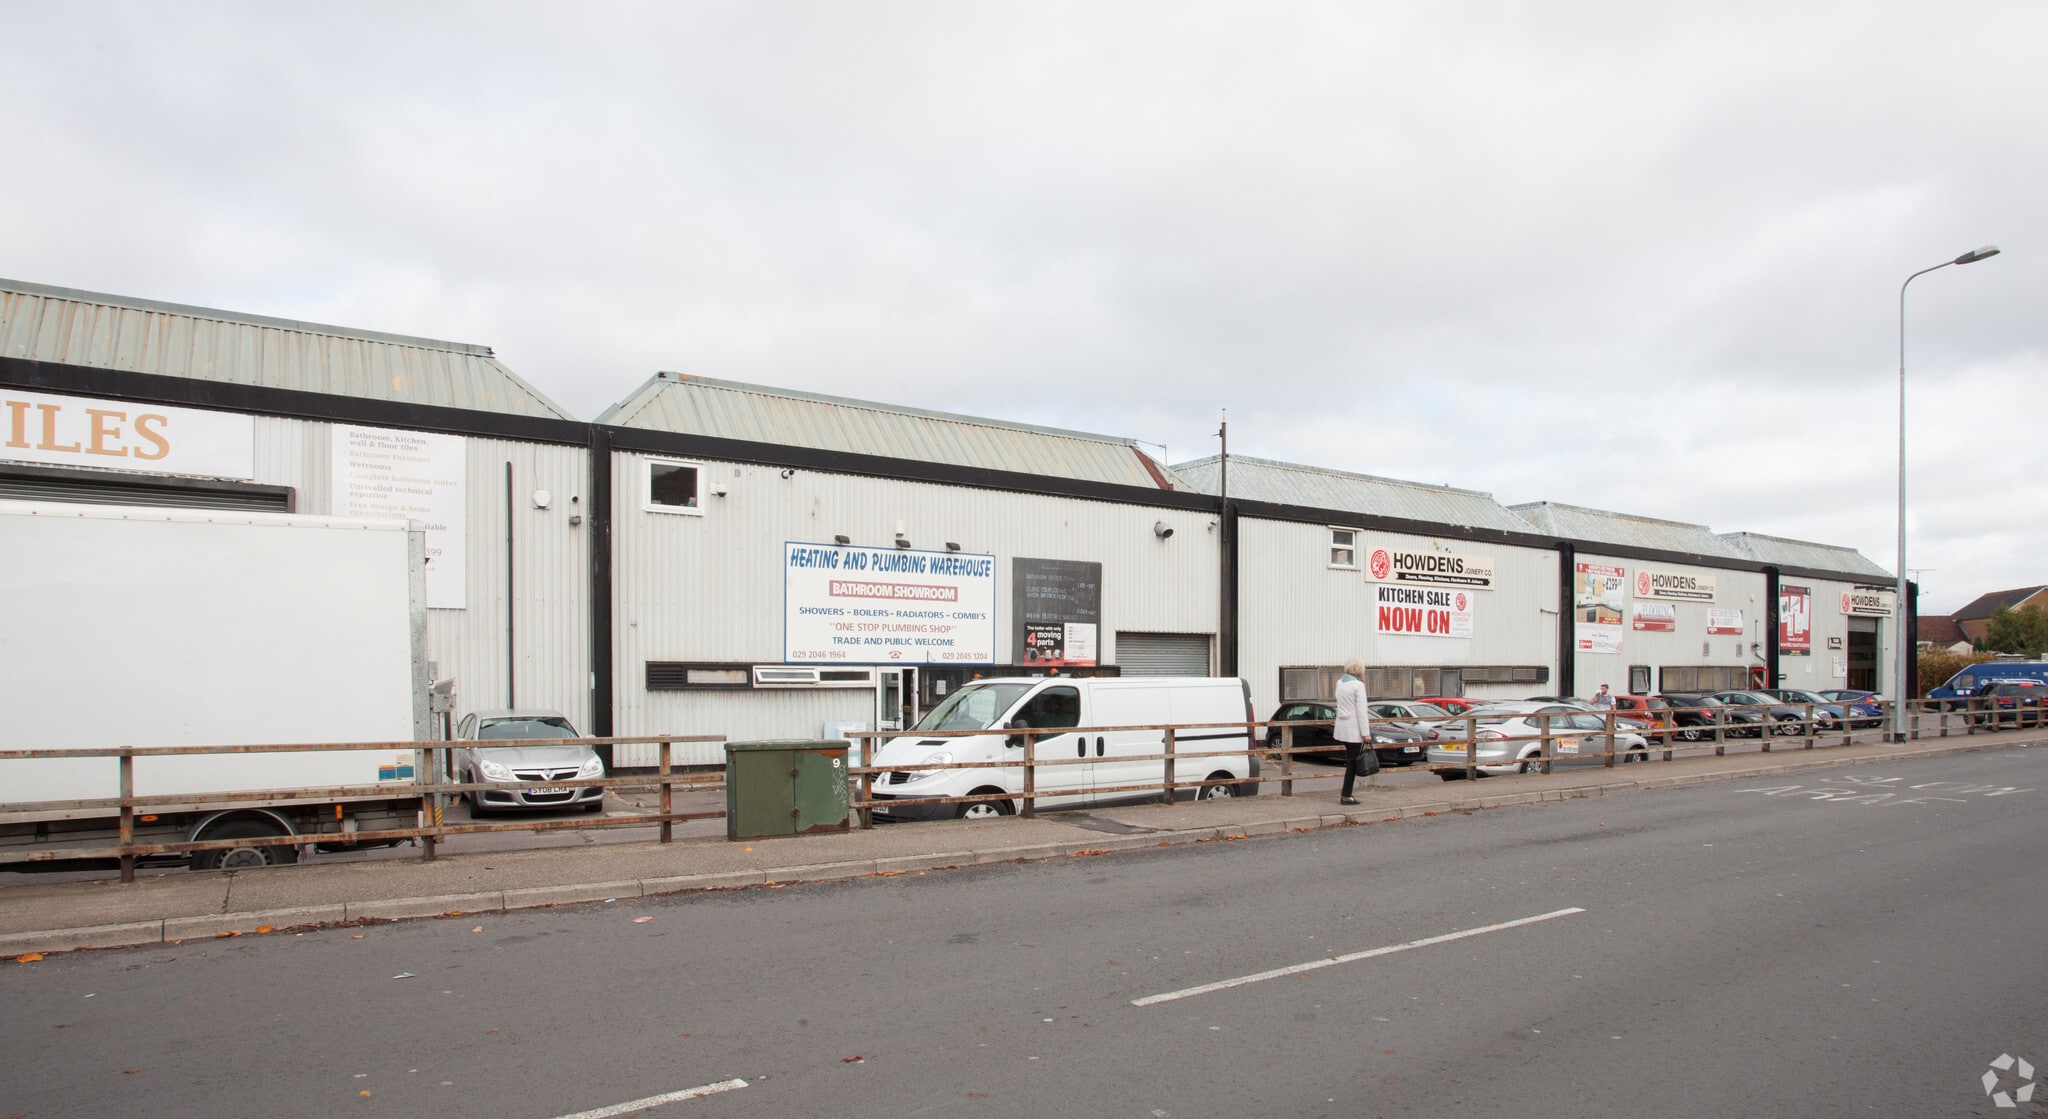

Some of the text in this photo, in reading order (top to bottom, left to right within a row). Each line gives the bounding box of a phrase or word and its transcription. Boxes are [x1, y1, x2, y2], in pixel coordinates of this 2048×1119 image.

[349, 432, 429, 445] Bathroom, Kitchen,
[378, 441, 399, 450] floor
[401, 443, 418, 452] tiles
[349, 451, 431, 463] Bathroom Furniture
[349, 461, 392, 470] Wetrooms
[349, 471, 389, 482] Complete
[391, 475, 432, 484] bathroom
[349, 483, 433, 496] Unrivalled technical
[349, 491, 389, 500] expertise
[370, 503, 398, 512] design
[408, 505, 431, 513] home
[790, 548, 991, 578] HEATING AND PLUMBING WAREHOUSE
[1393, 552, 1464, 574] HOWDENS
[1464, 567, 1484, 576] JOINERY
[1652, 573, 1697, 590] HOWDENS
[832, 582, 955, 600] BATHROOM SHOWROOM
[1379, 587, 1450, 607] KITCHEN SALE
[1851, 594, 1880, 608] HOWDENS
[799, 606, 844, 616] SHOWERS
[853, 608, 889, 617] BOILERS
[896, 610, 944, 619] RADIATORS
[1378, 606, 1423, 632] NOW
[1427, 609, 1450, 634] ON
[858, 623, 880, 632] STOP
[882, 623, 927, 633] PLUMBING
[832, 636, 955, 647] TRADE AND PUBLIC WELCOME
[1026, 632, 1037, 646] 4
[1037, 631, 1062, 640] moving
[1037, 639, 1054, 647] parts
[792, 650, 807, 659] 029
[807, 651, 827, 659] 2046
[829, 650, 846, 659] 1964
[942, 652, 953, 660] 029
[973, 652, 988, 660] 1204
[832, 758, 841, 768] 9
